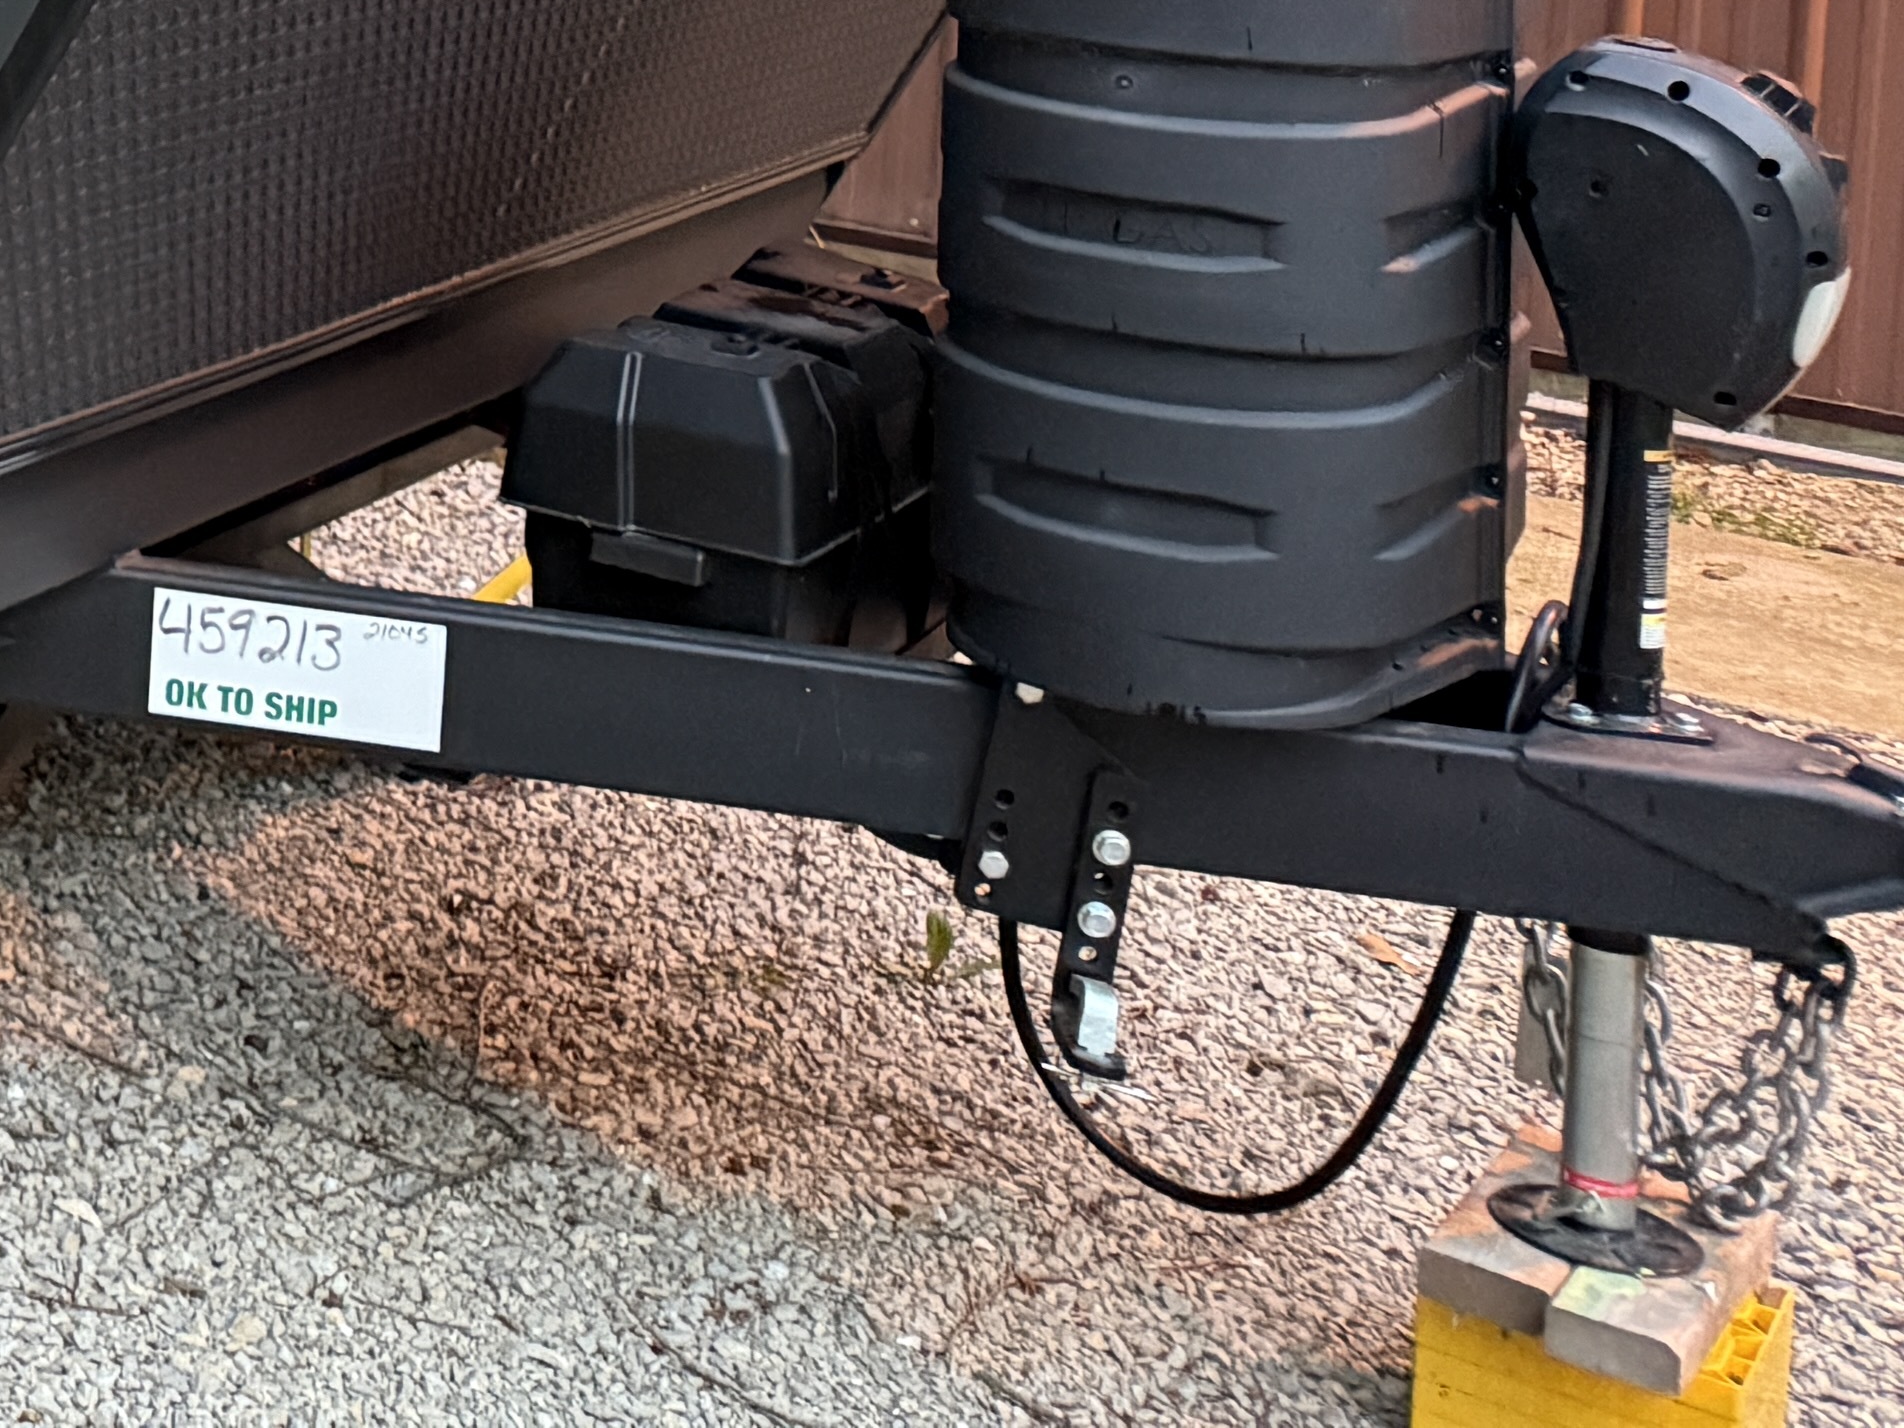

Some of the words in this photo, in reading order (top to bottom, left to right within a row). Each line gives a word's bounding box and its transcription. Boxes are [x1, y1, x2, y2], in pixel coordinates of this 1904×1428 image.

[159, 597, 342, 672] 459213
[165, 678, 208, 710] OK
[217, 685, 254, 716] TO
[264, 692, 338, 726] SHIP
